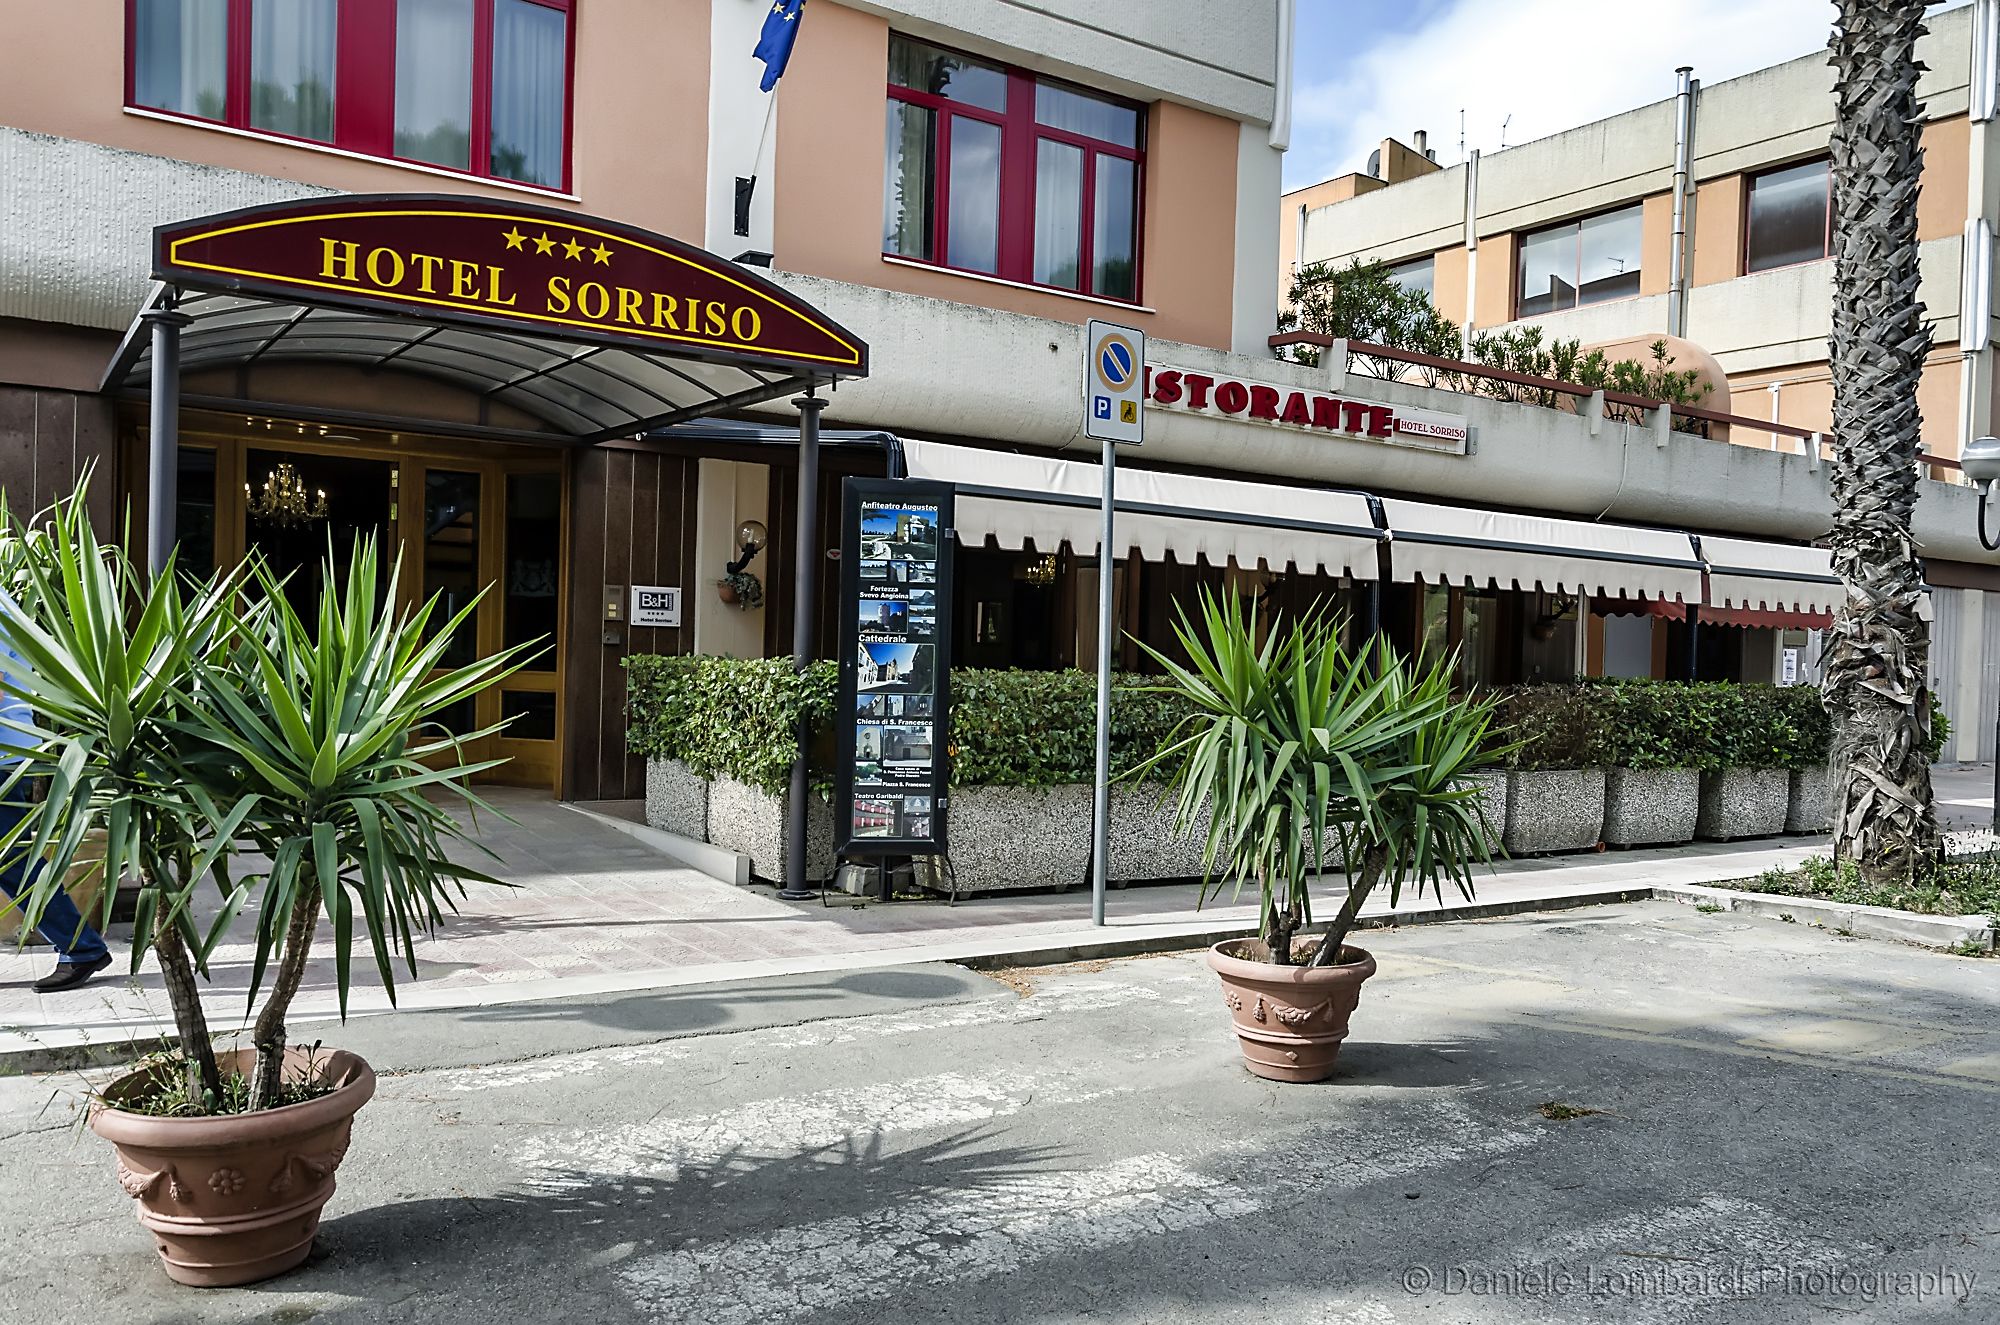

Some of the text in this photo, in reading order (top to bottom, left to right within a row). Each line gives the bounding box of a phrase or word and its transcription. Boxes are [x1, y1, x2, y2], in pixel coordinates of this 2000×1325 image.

[319, 237, 762, 341] HOTEL SORRISO
[1097, 399, 1108, 416] P
[1144, 366, 1394, 438] ISTORANTE
[1400, 420, 1466, 439] HOTEL SORRISO
[861, 501, 938, 511] Anfiteatro Augusteo
[641, 593, 669, 608] B&H
[858, 634, 907, 643] Cattedrale
